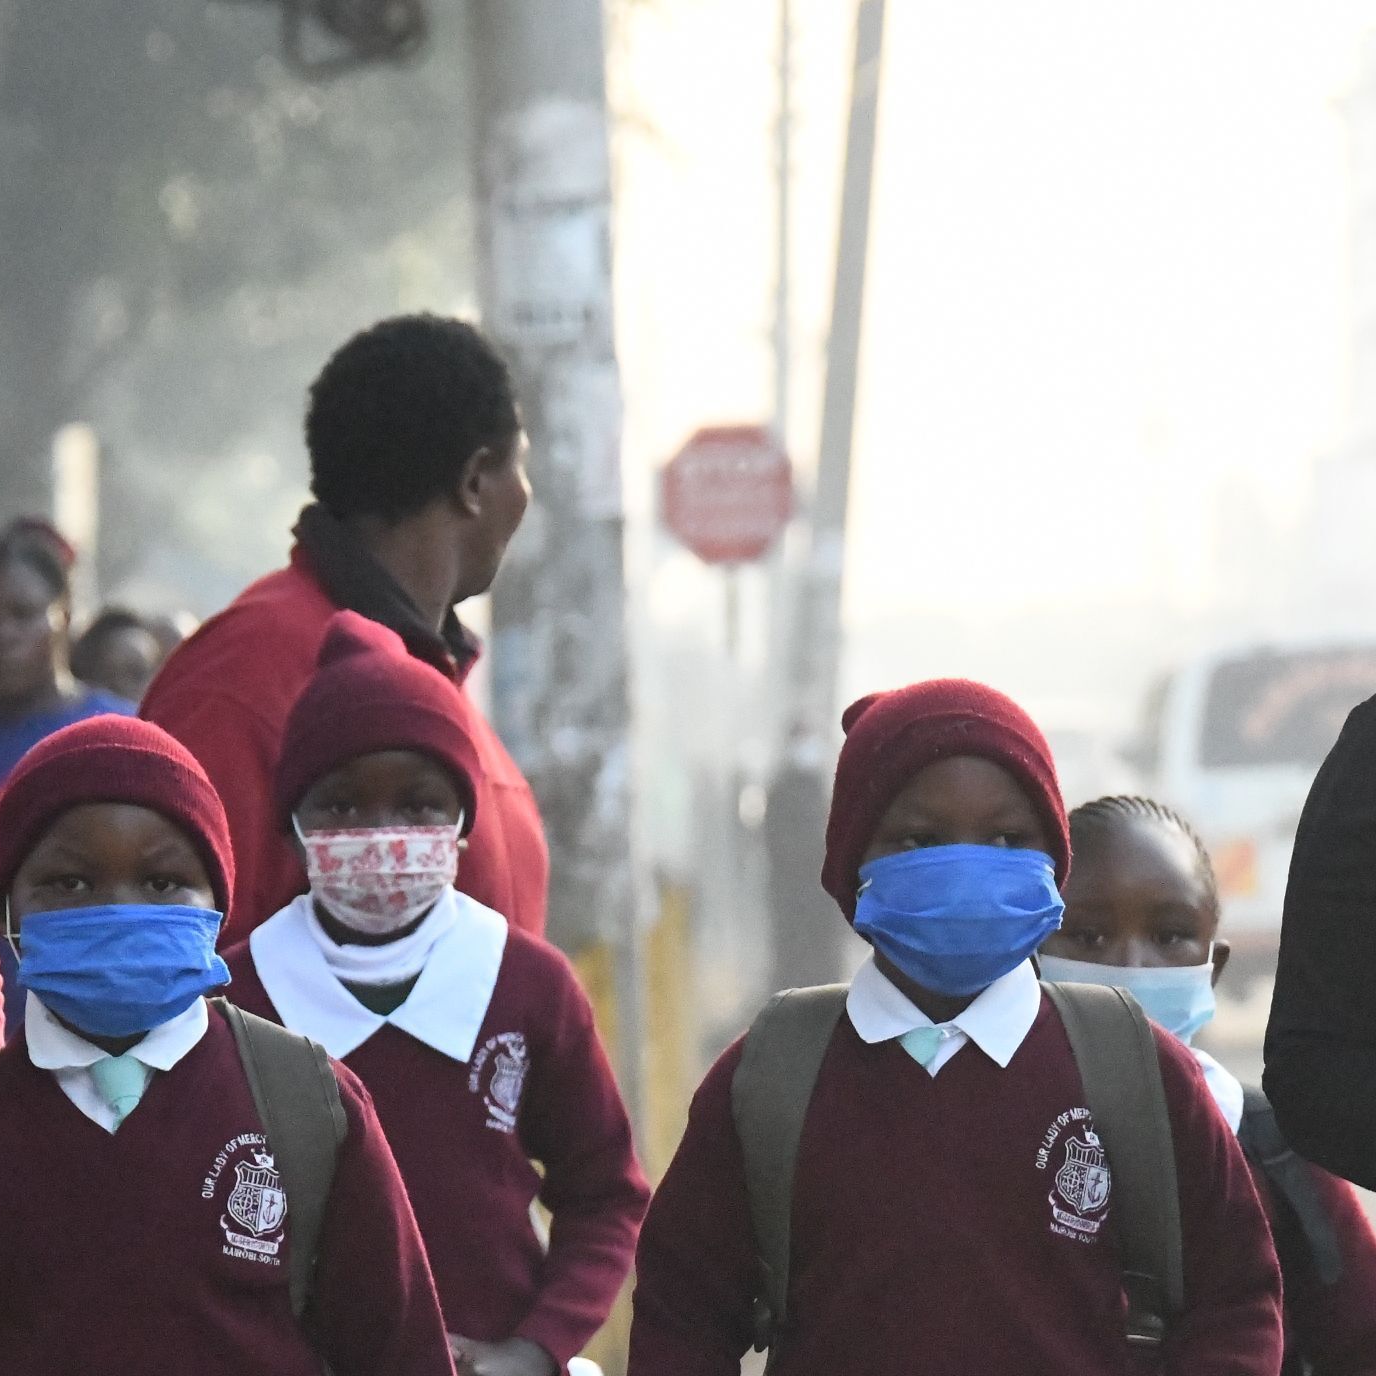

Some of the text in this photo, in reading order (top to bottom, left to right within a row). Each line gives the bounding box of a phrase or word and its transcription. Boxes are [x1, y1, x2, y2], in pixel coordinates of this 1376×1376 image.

[1057, 1111, 1070, 1126] OF
[1041, 1121, 1061, 1148] LADY
[201, 1132, 267, 1198] OUR LADY OF MERCY
[1035, 1147, 1050, 1169] OUR
